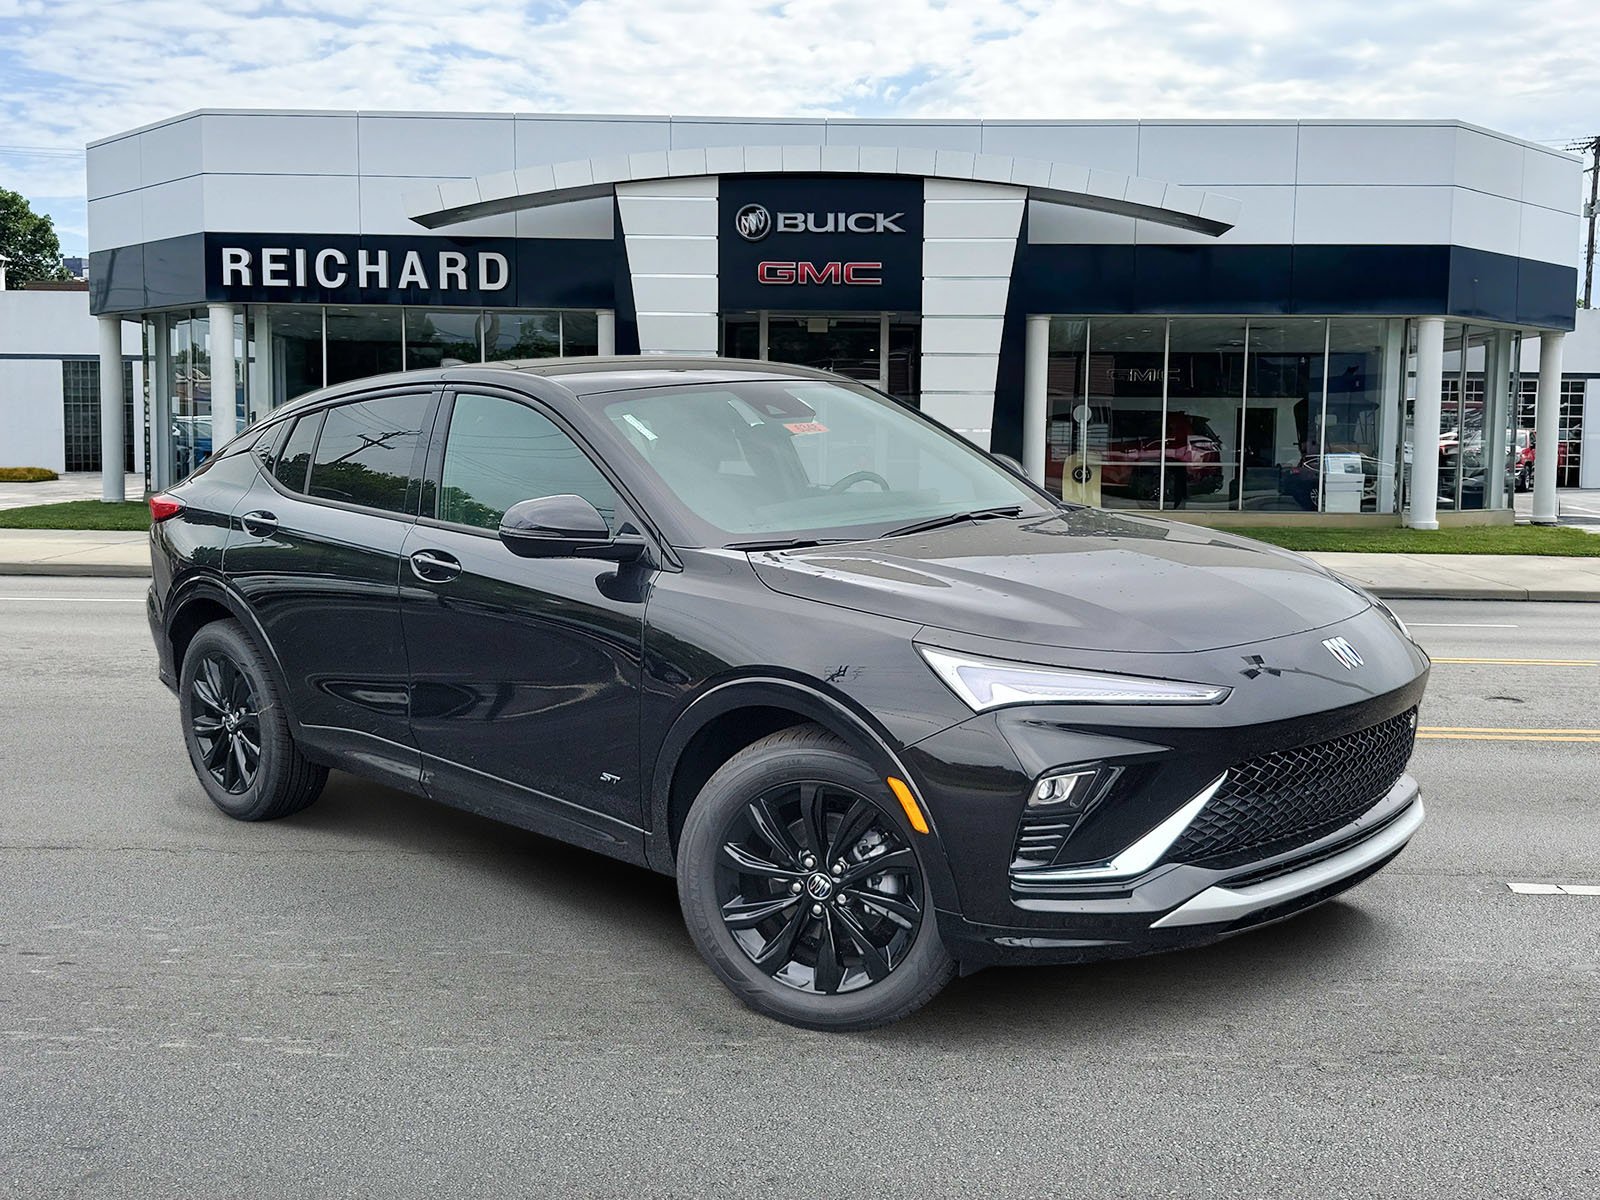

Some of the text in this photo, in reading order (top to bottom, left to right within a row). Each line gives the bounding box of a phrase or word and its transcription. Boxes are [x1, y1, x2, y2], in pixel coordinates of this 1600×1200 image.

[777, 212, 906, 233] BUICK
[222, 247, 509, 290] REICHARD
[758, 261, 882, 285] GMC
